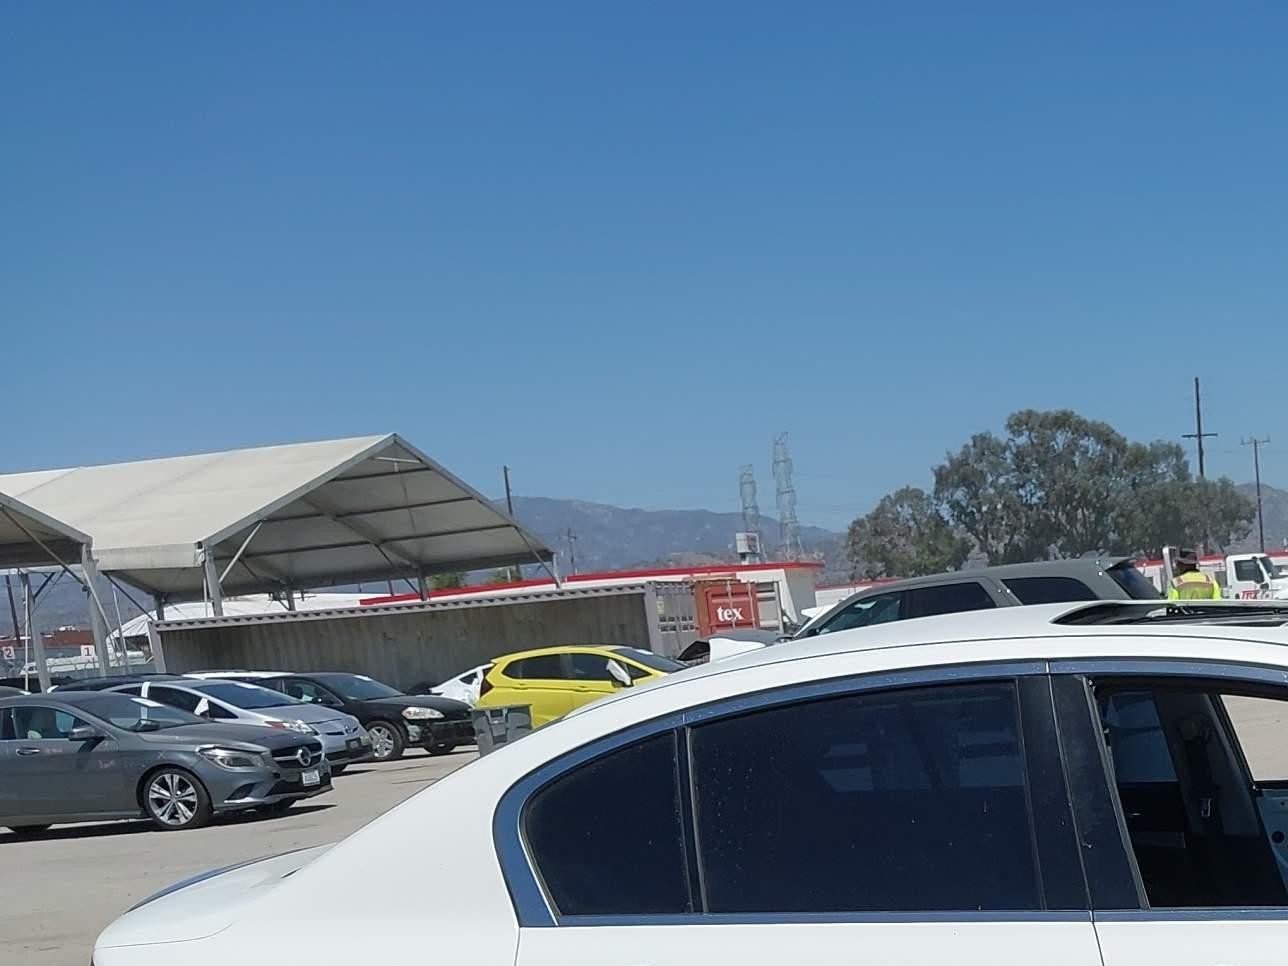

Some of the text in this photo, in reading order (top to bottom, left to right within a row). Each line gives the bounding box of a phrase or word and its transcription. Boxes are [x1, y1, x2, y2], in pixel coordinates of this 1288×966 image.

[717, 606, 744, 622] tex
[5, 648, 12, 658] 2
[84, 647, 92, 657] 1
